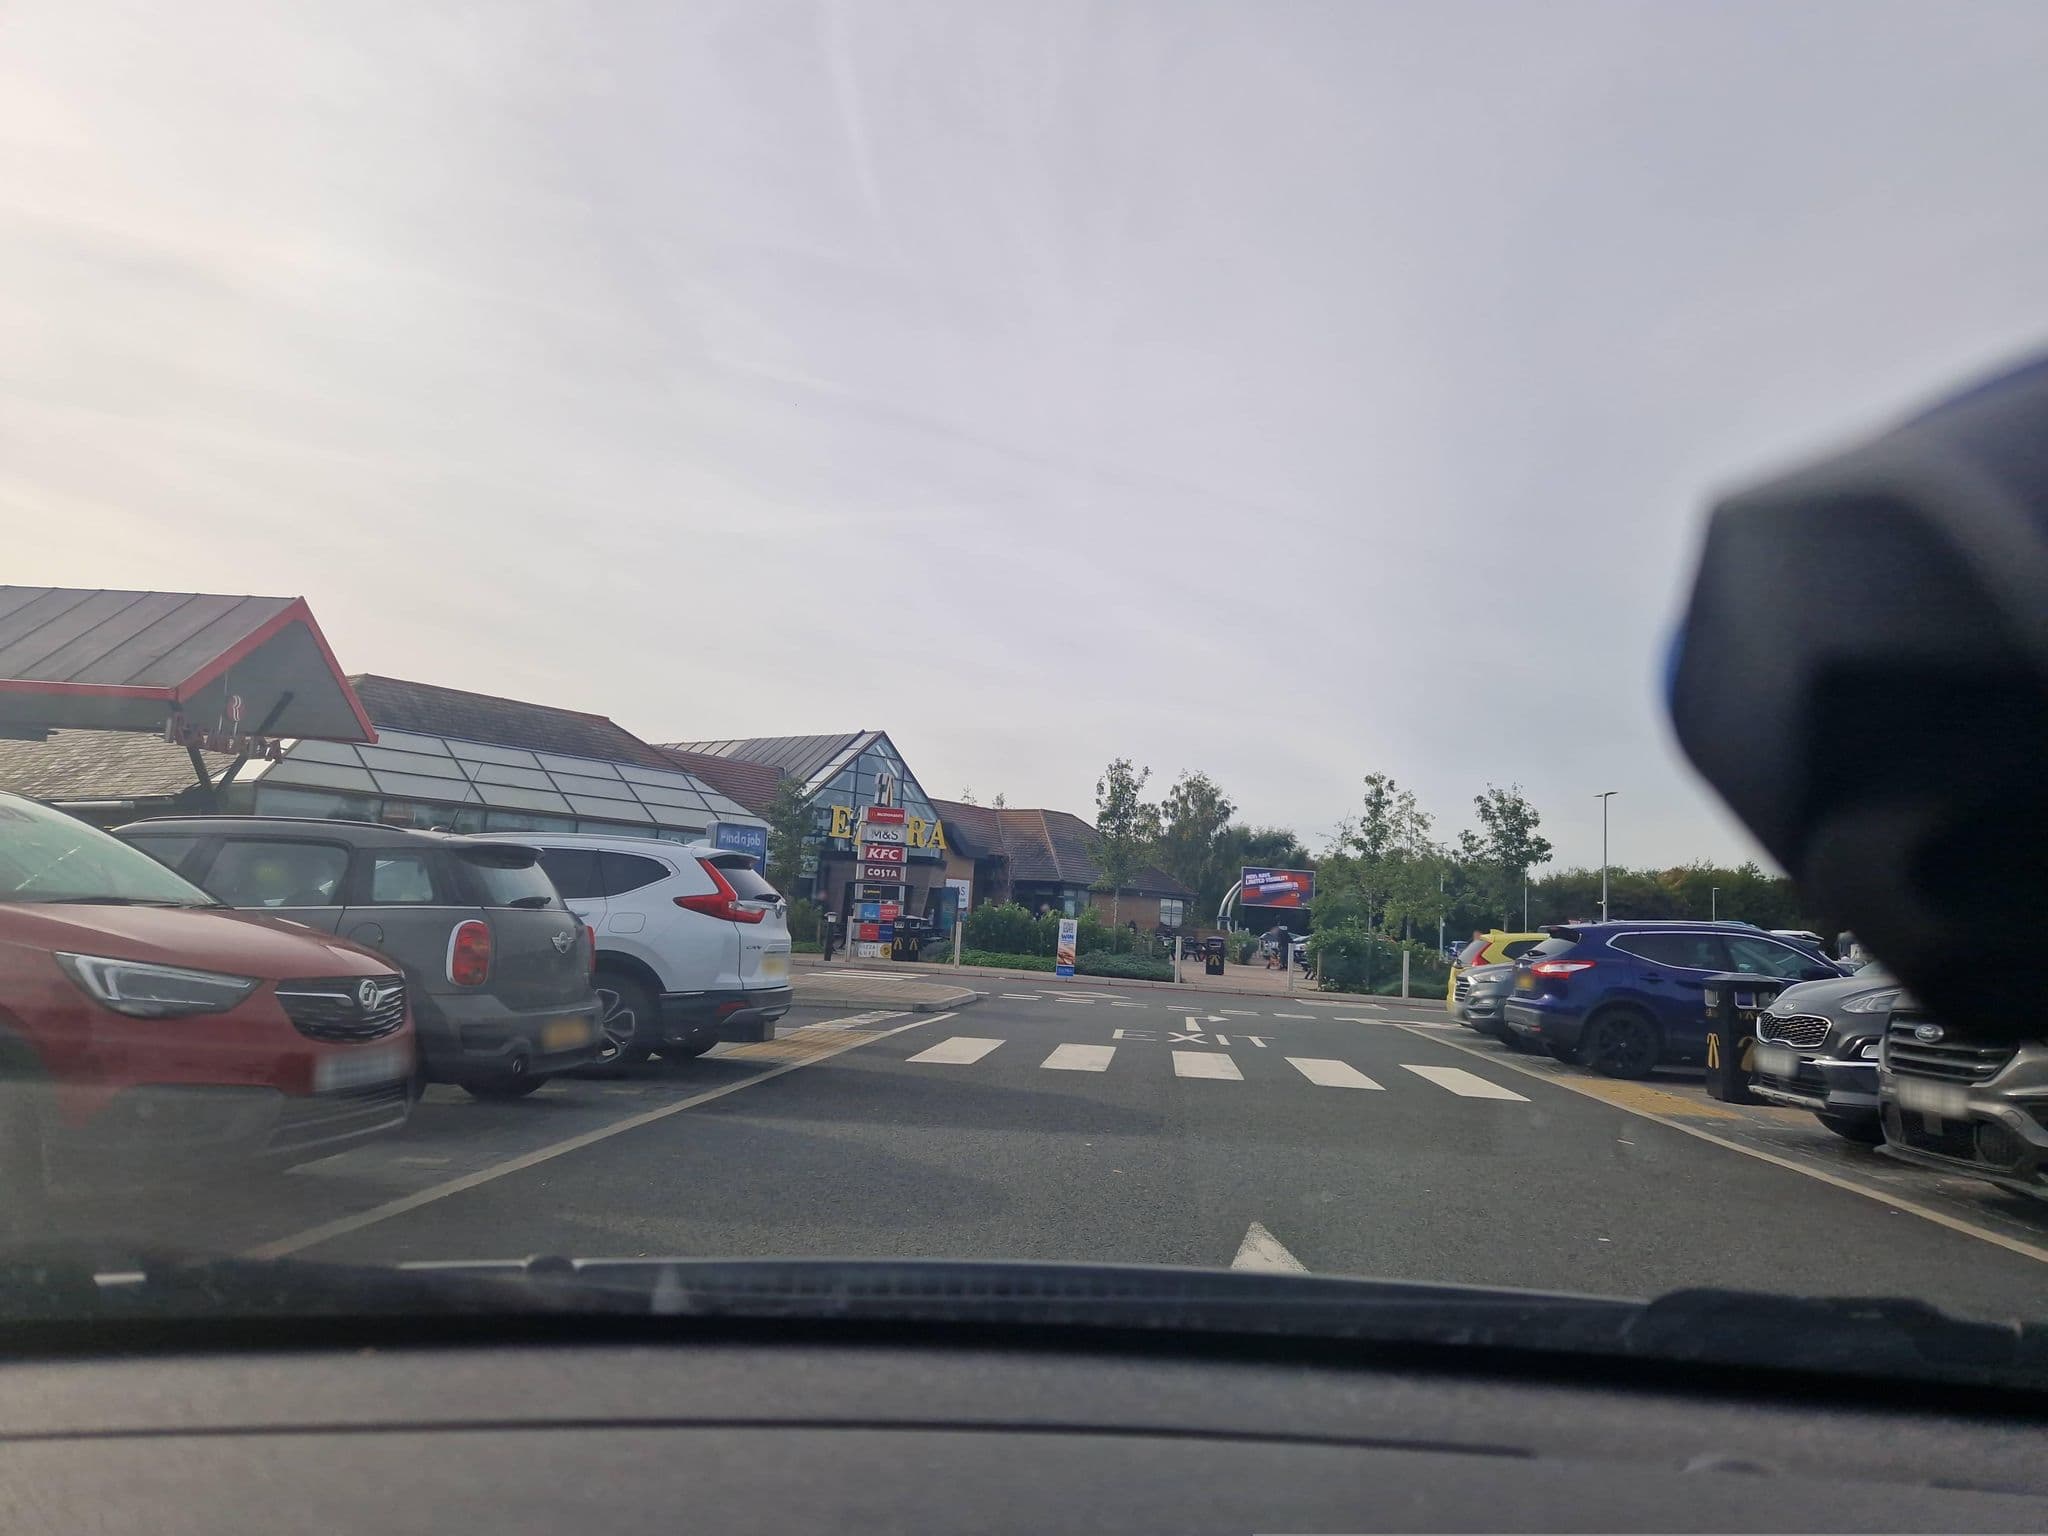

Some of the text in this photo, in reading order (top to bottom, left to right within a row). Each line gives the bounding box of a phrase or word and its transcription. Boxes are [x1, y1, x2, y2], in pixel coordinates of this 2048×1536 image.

[829, 804, 947, 849] ERA
[746, 832, 760, 848] job
[867, 848, 900, 860] KFC
[867, 868, 898, 878] COSTA
[1112, 1028, 1276, 1048] EXIT
